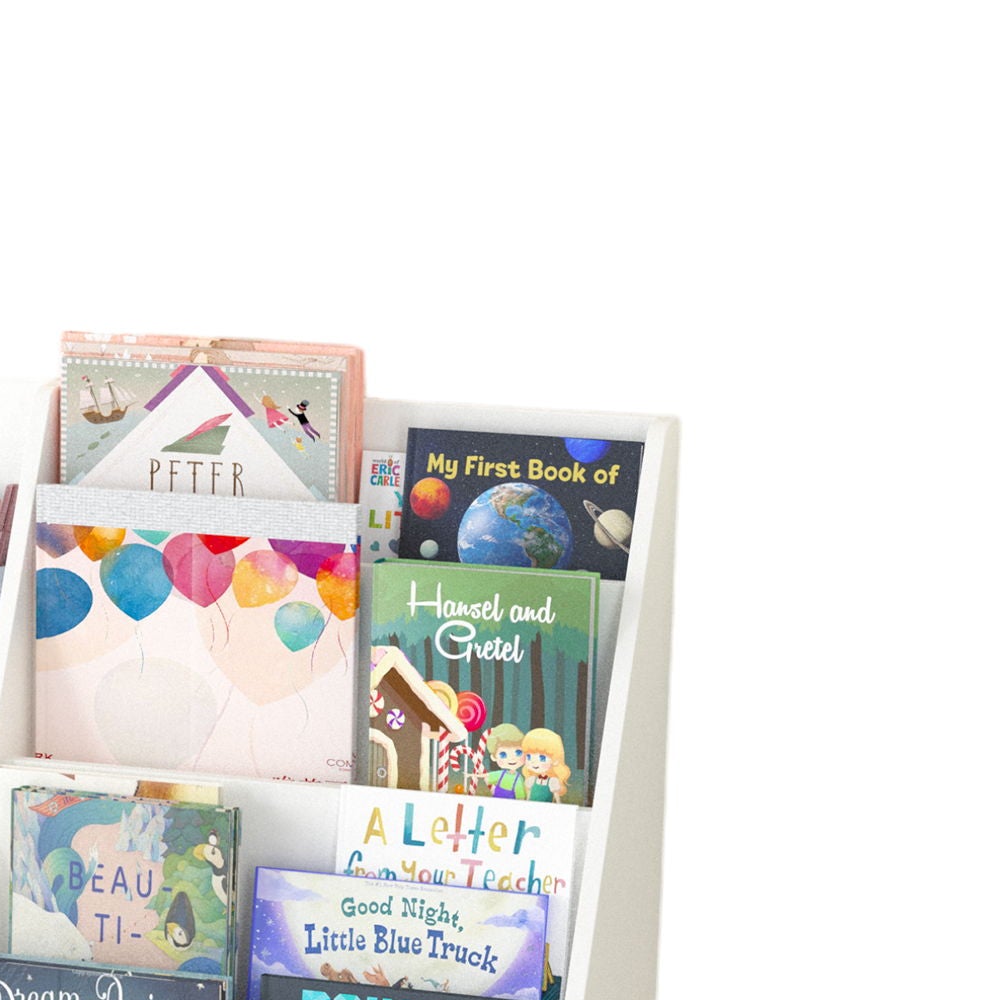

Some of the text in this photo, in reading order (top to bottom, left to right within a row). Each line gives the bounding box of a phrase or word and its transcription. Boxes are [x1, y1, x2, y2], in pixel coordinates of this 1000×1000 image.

[370, 475, 400, 487] CARLE
[371, 463, 401, 476] ERIC
[427, 453, 620, 485] My First Book of
[407, 580, 556, 624] Hansel and
[435, 620, 524, 663] Gretel
[363, 802, 542, 855] A Letter
[460, 858, 567, 896] Teacher
[94, 913, 142, 944] TI-
[341, 896, 465, 934] Good Night,
[304, 923, 499, 974] Little Blue Truck
